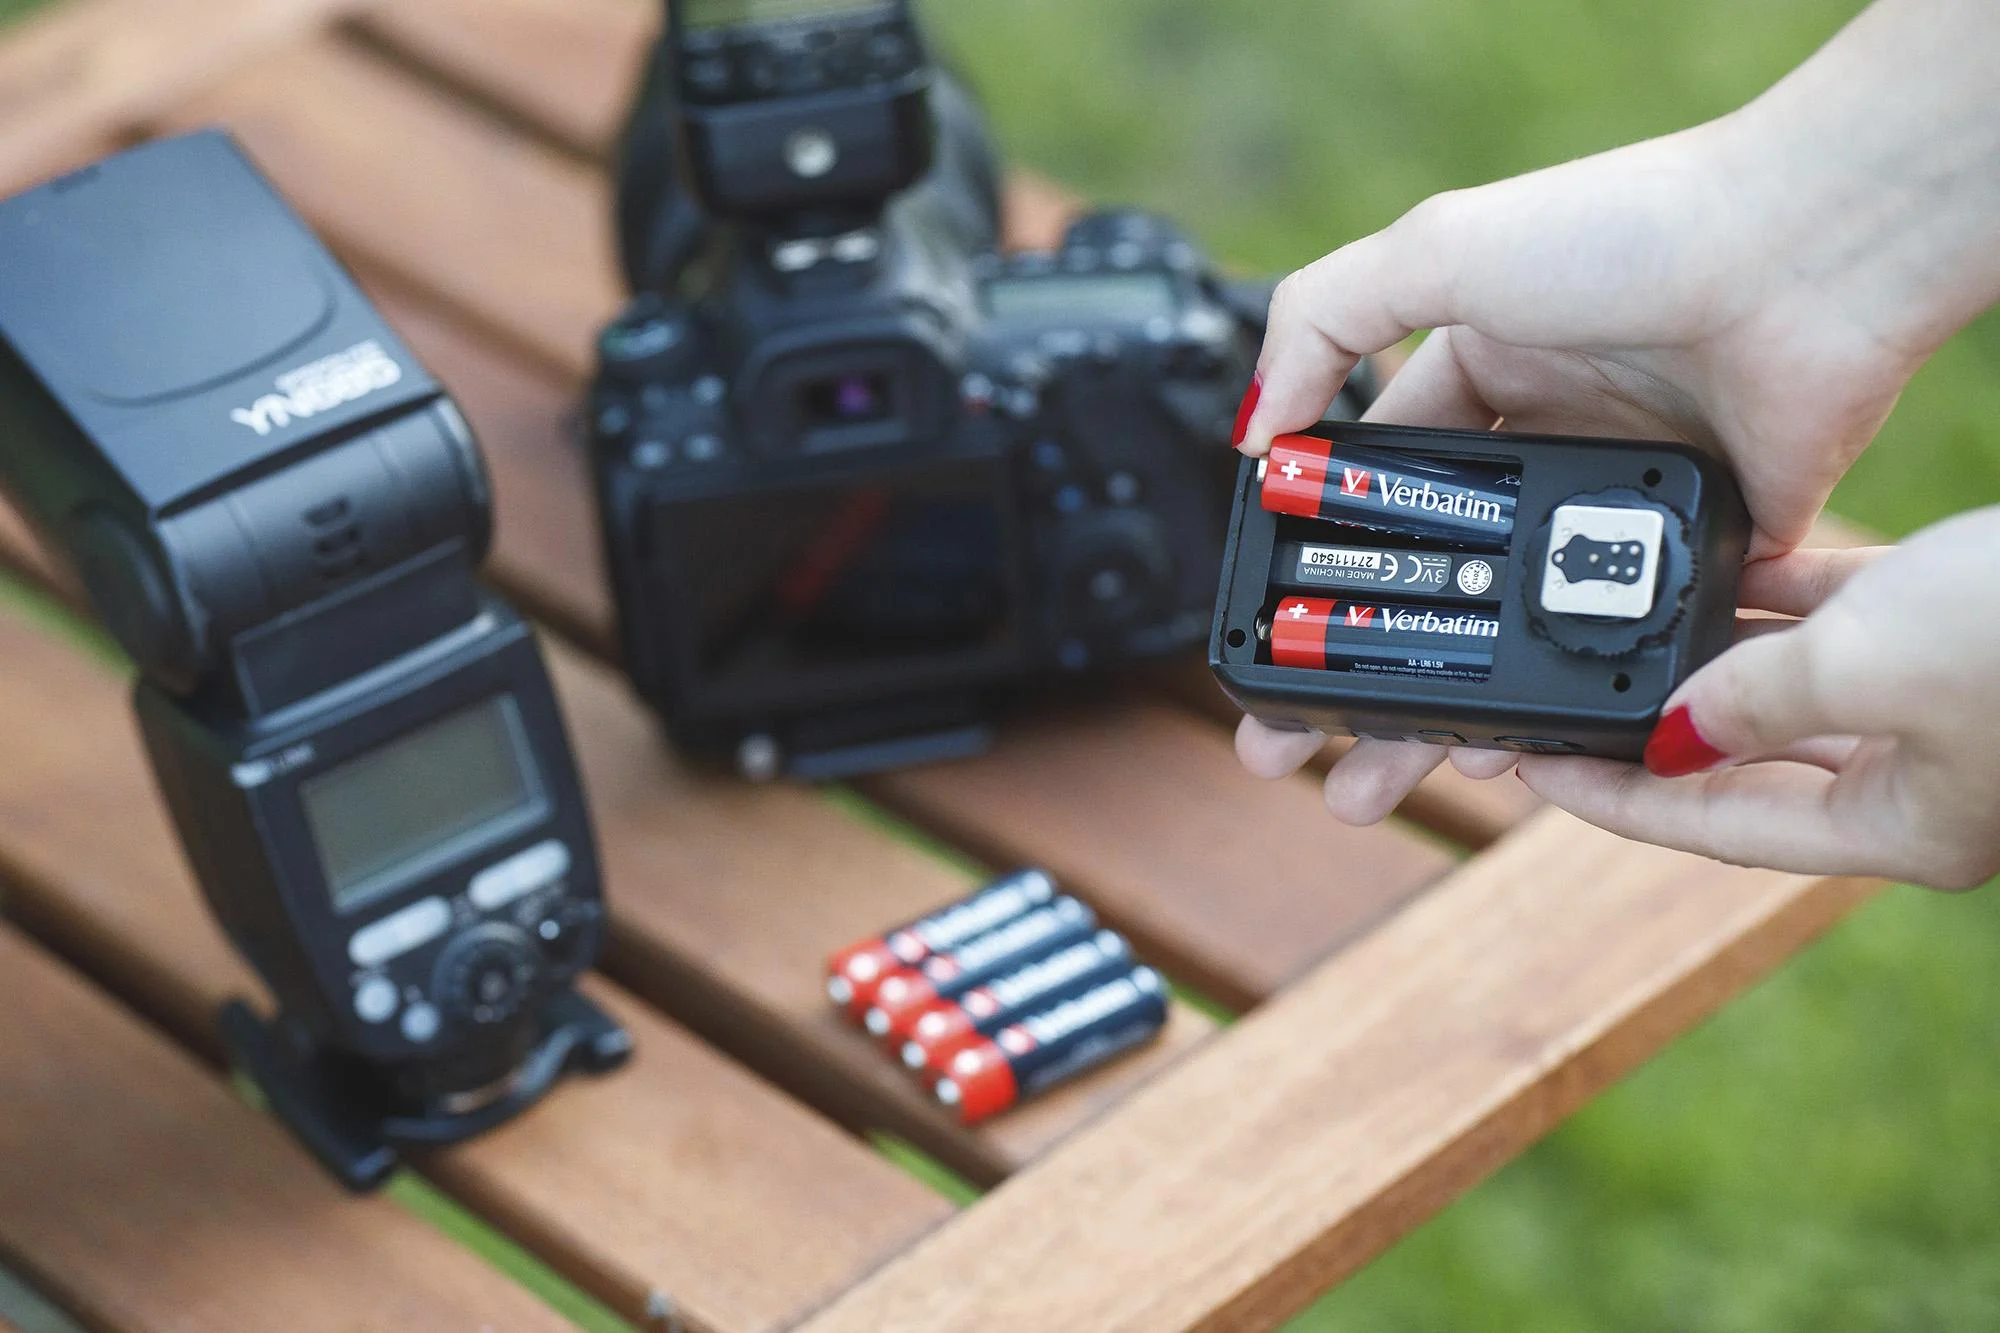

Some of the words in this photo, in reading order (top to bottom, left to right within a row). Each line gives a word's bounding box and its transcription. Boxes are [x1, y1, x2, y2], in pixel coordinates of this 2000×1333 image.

[1378, 474, 1501, 523] Verbatim
[1311, 552, 1374, 568] 27111540
[1303, 566, 1333, 577] CHINA
[1334, 569, 1345, 577] IN
[1347, 570, 1375, 580] MADE
[1422, 568, 1445, 584] 3V
[1471, 569, 1481, 585] 2013
[1381, 607, 1500, 637] Verbatim
[1408, 659, 1417, 667] AA
[1431, 660, 1444, 669] 1.5V
